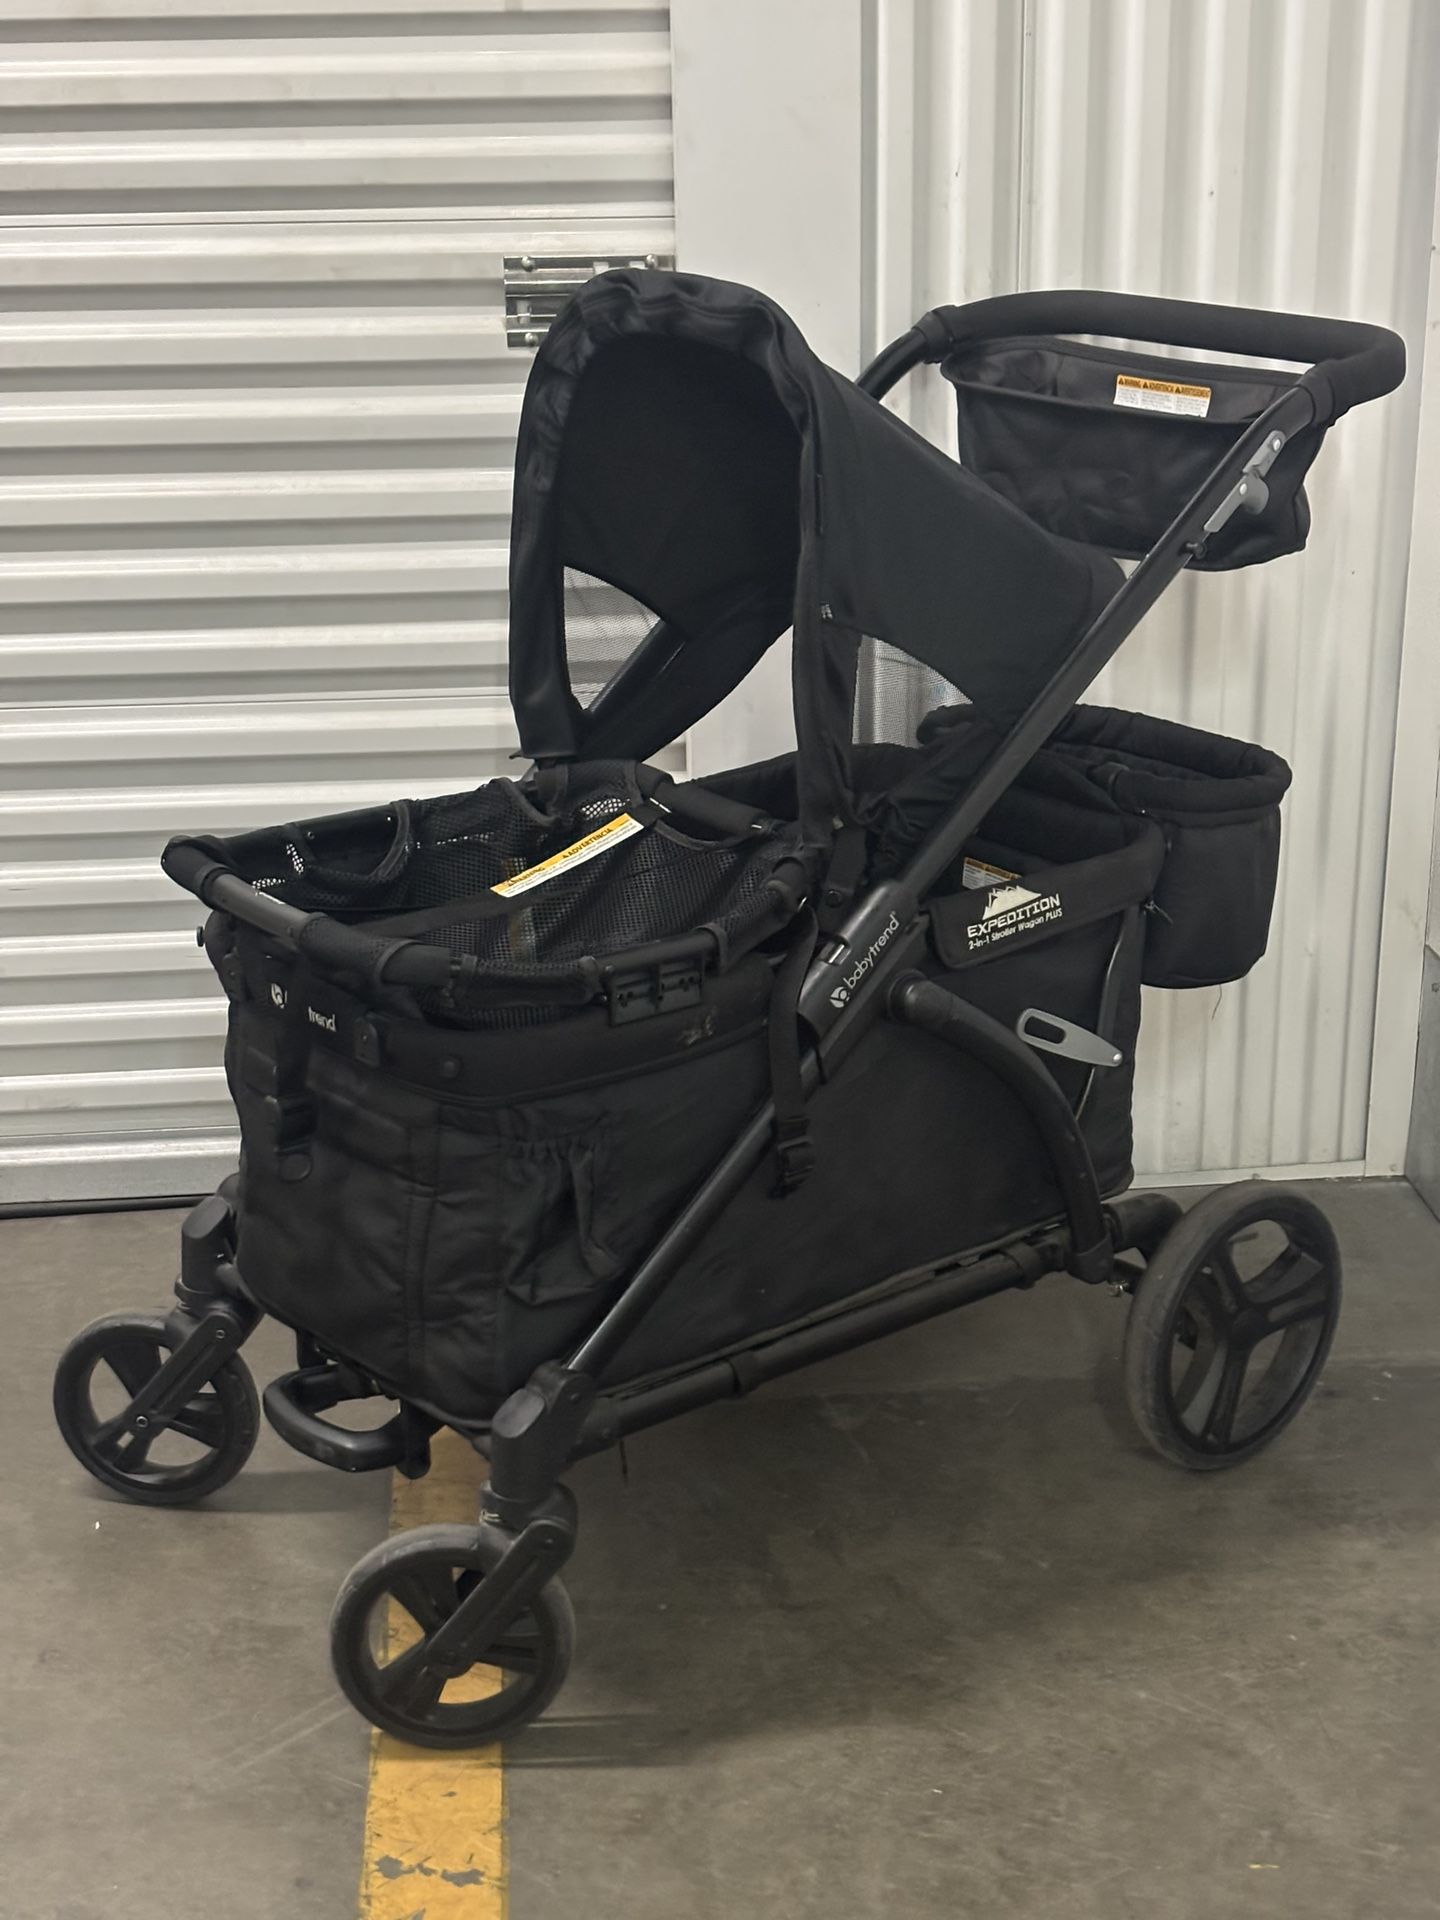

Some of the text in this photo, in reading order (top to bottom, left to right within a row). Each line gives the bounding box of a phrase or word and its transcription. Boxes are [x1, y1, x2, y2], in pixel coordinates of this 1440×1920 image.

[967, 893, 1061, 938] EXPEDITION
[991, 926, 1017, 941] Stroller
[1017, 916, 1044, 932] Wagon
[1045, 908, 1063, 922] PLUS
